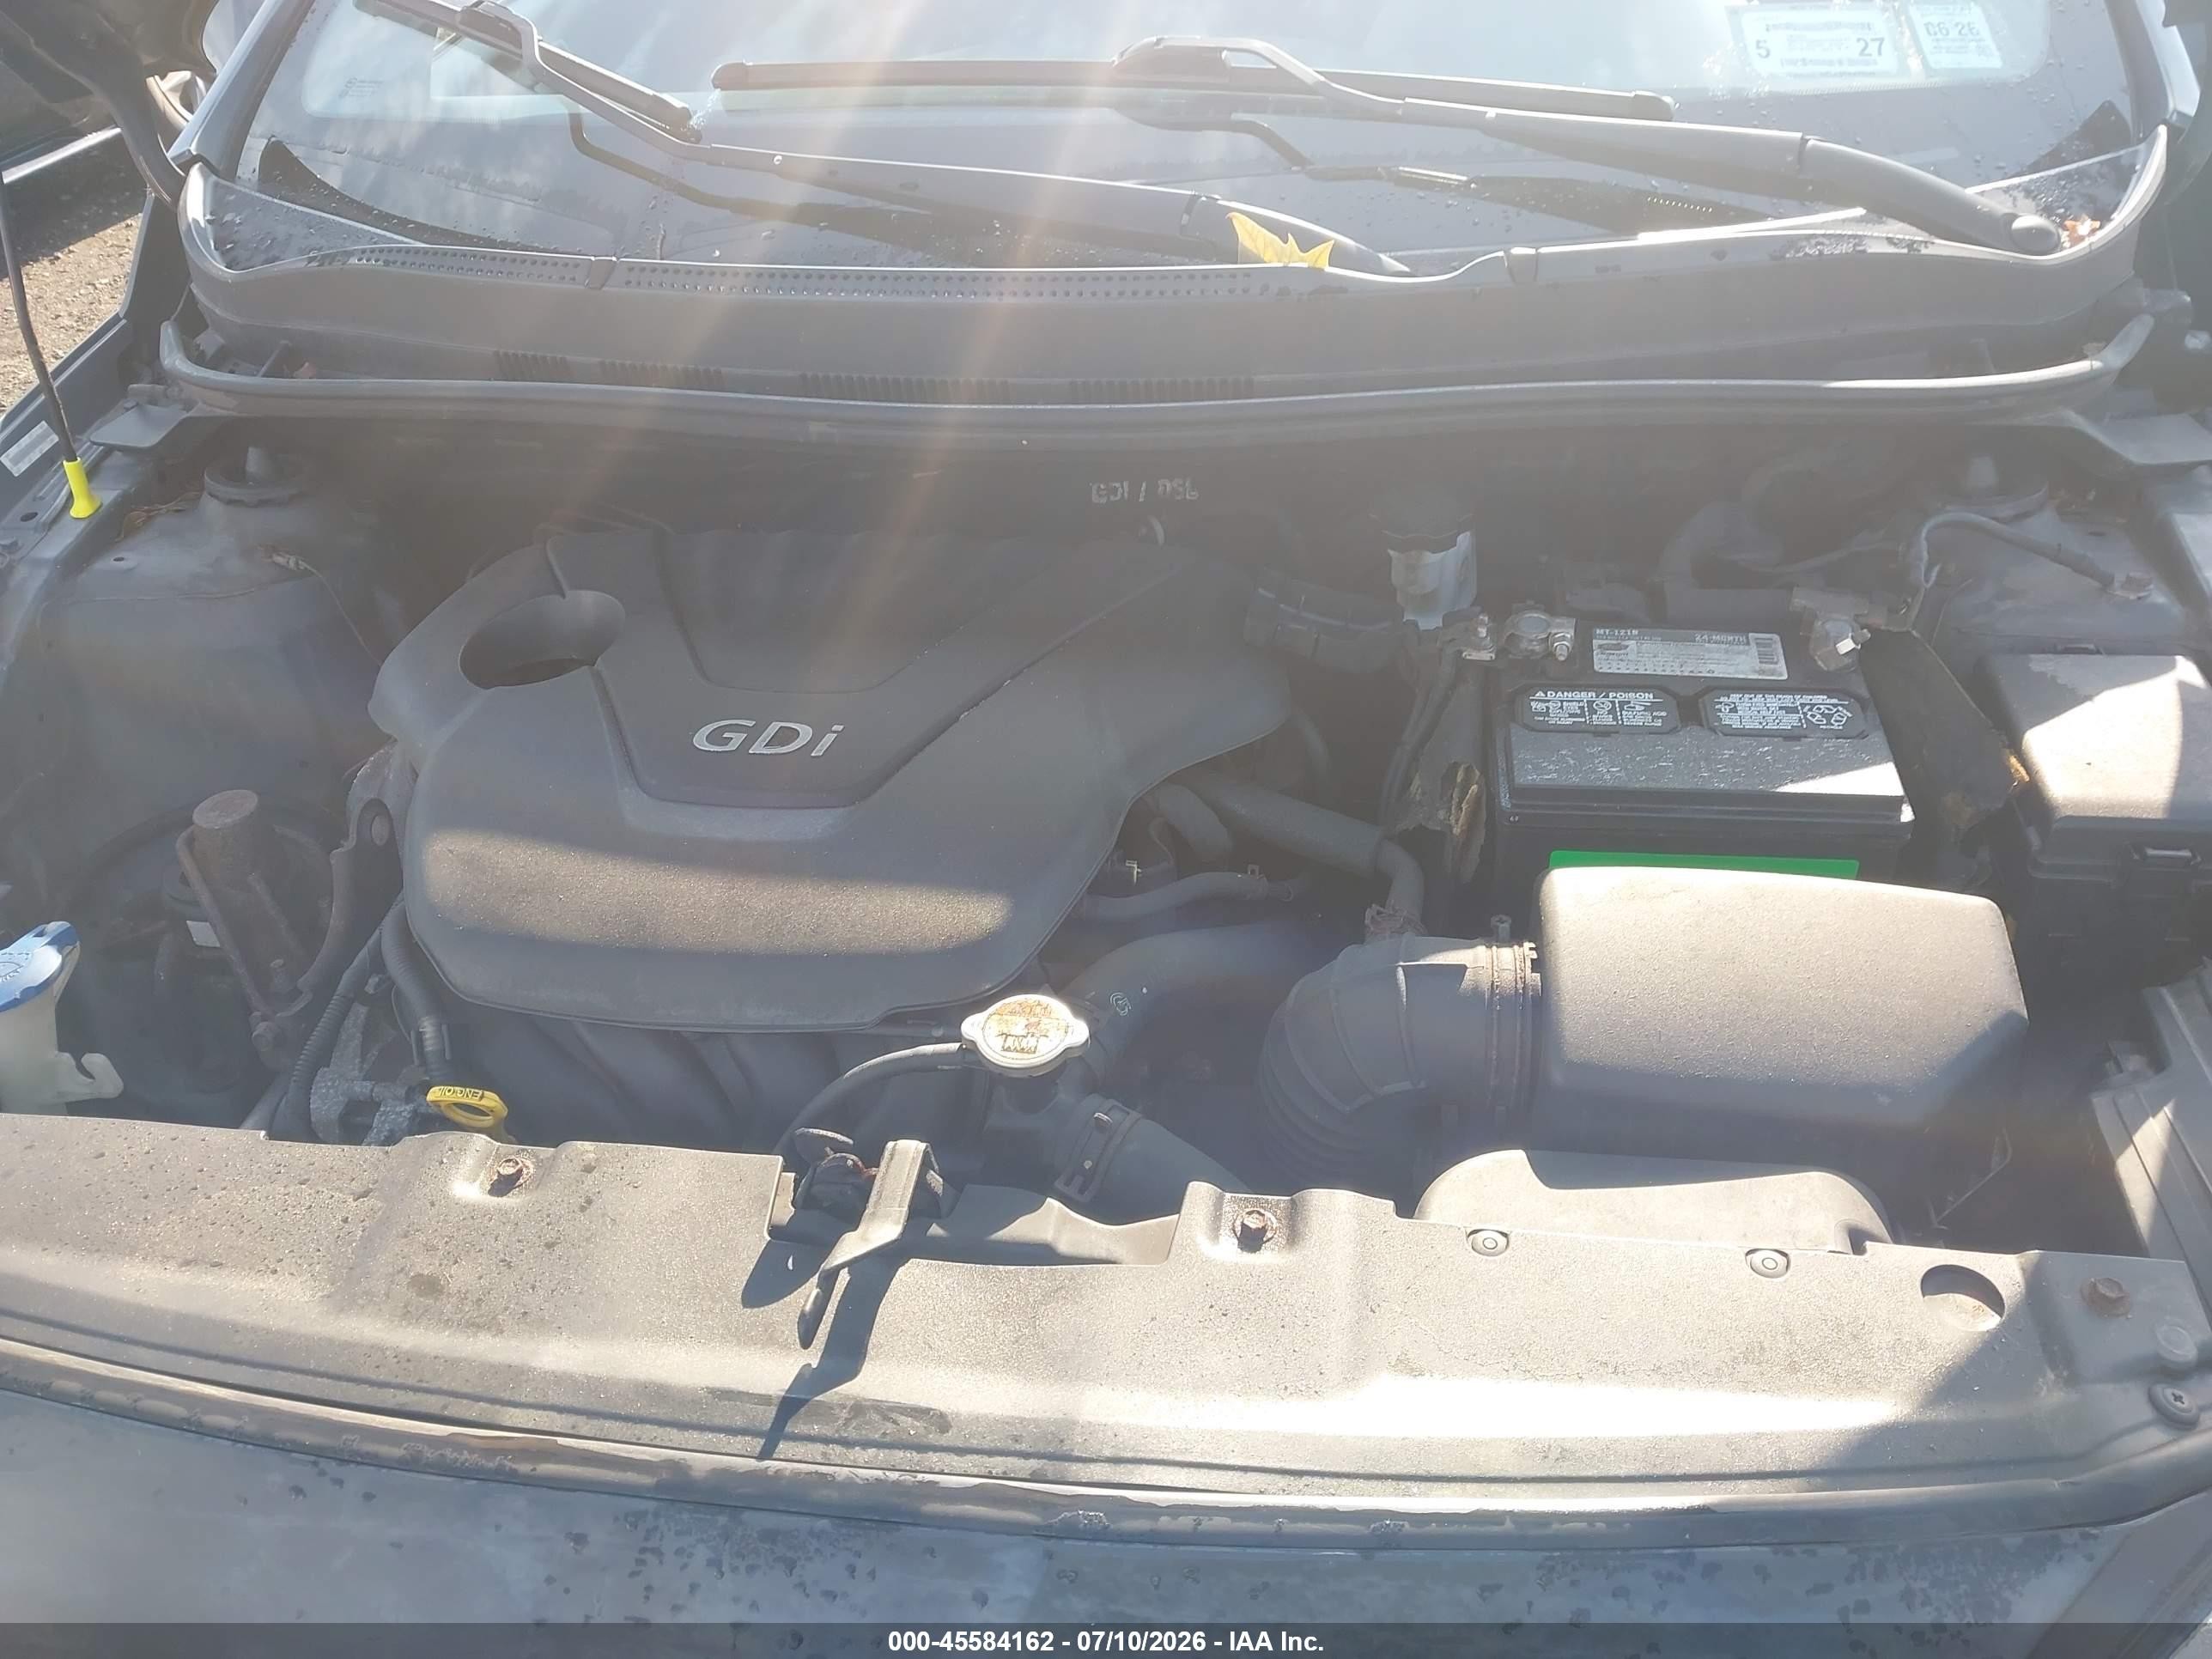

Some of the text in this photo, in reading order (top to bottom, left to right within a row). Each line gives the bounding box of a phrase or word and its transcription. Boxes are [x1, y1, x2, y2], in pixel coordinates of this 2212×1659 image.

[1755, 40, 1771, 58] 5
[1856, 37, 1885, 57] 27
[1608, 691, 1654, 700] POISON
[692, 719, 845, 757] GDi
[438, 1086, 483, 1100] ENG OIL
